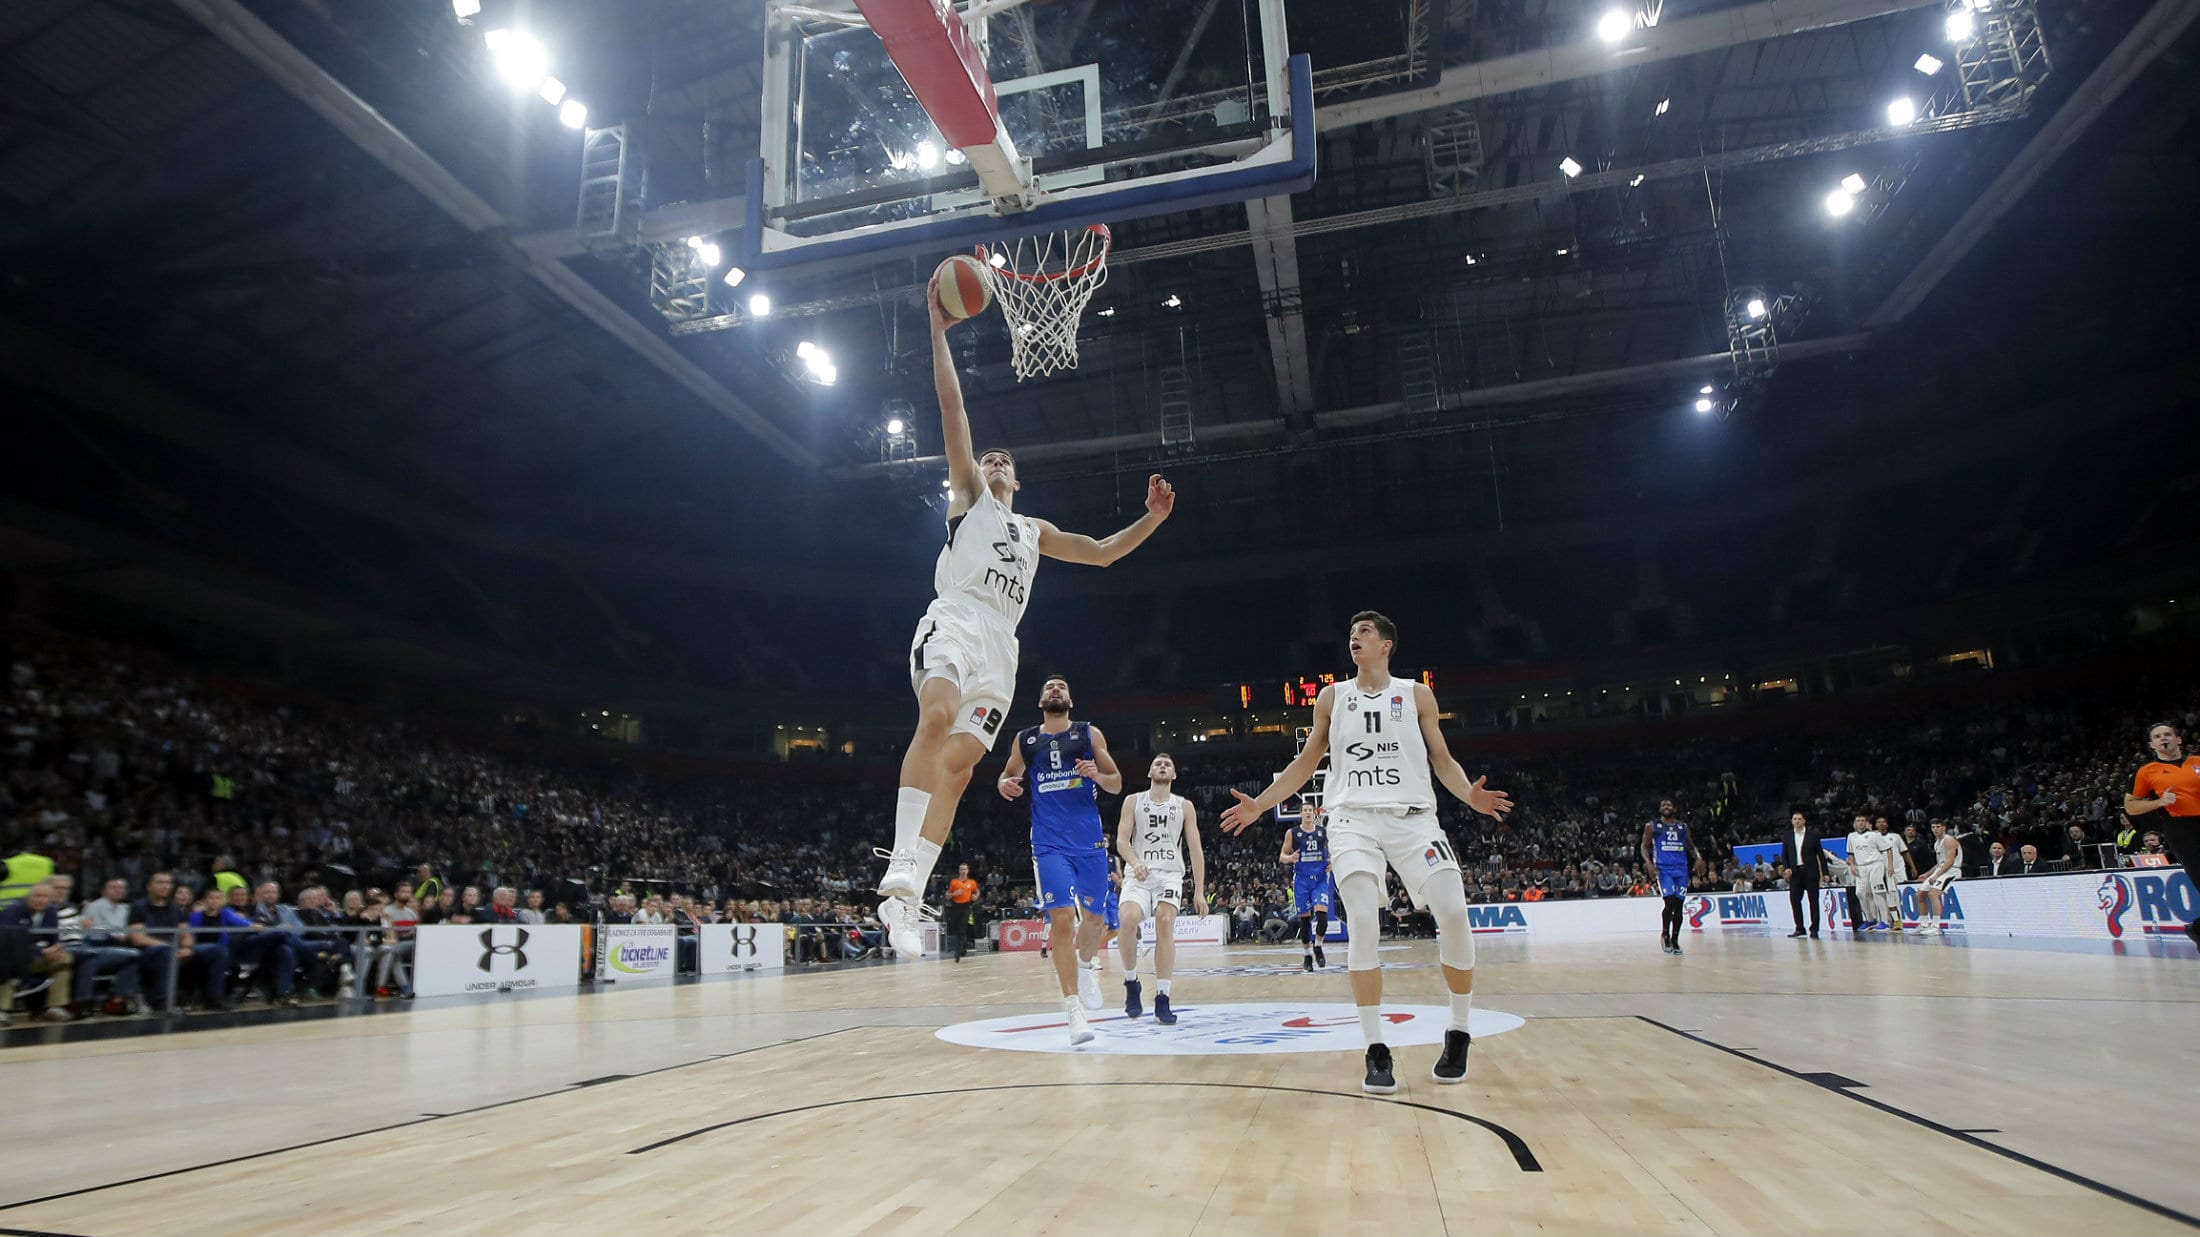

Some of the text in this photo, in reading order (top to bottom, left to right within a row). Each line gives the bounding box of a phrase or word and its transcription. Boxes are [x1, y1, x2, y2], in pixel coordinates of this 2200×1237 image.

[984, 567, 1025, 605] mts
[1363, 711, 1381, 734] 11
[1377, 742, 1399, 752] NIS
[1050, 750, 1062, 769] 9
[1347, 765, 1400, 787] mts
[1148, 814, 1168, 828] 34
[1666, 831, 1679, 841] 23
[1306, 840, 1318, 851] 29
[1143, 847, 1175, 861] mts
[1717, 894, 1768, 919] ROMA
[464, 979, 536, 992] UNDER ARMOUR
